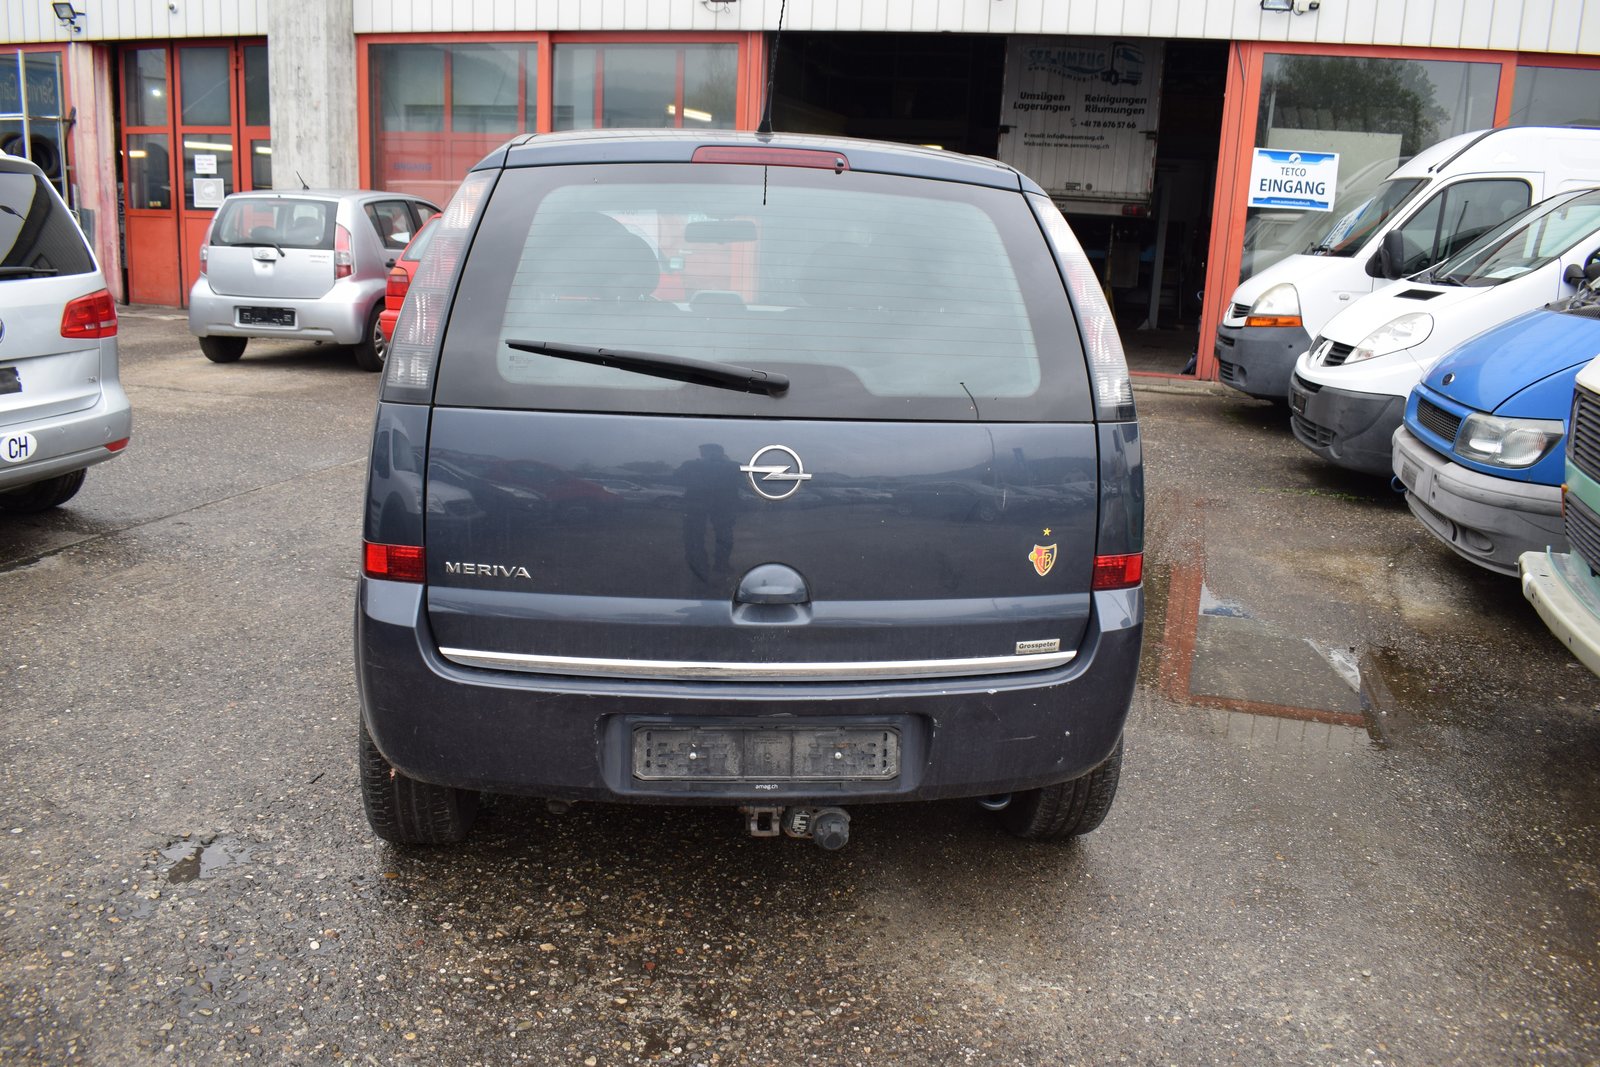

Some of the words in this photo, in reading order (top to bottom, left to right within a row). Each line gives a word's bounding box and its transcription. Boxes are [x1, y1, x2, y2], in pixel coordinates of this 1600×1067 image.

[1020, 91, 1066, 103] Umzügen
[1084, 94, 1147, 106] Reinigungen
[1013, 102, 1071, 113] Lagerungen
[1085, 104, 1145, 116] Räumungen
[1280, 166, 1307, 177] TETCO
[1259, 178, 1326, 196] EINGANG
[8, 435, 28, 459] CH
[445, 561, 532, 579] MERIVA
[1018, 641, 1057, 650] Grosspeter
